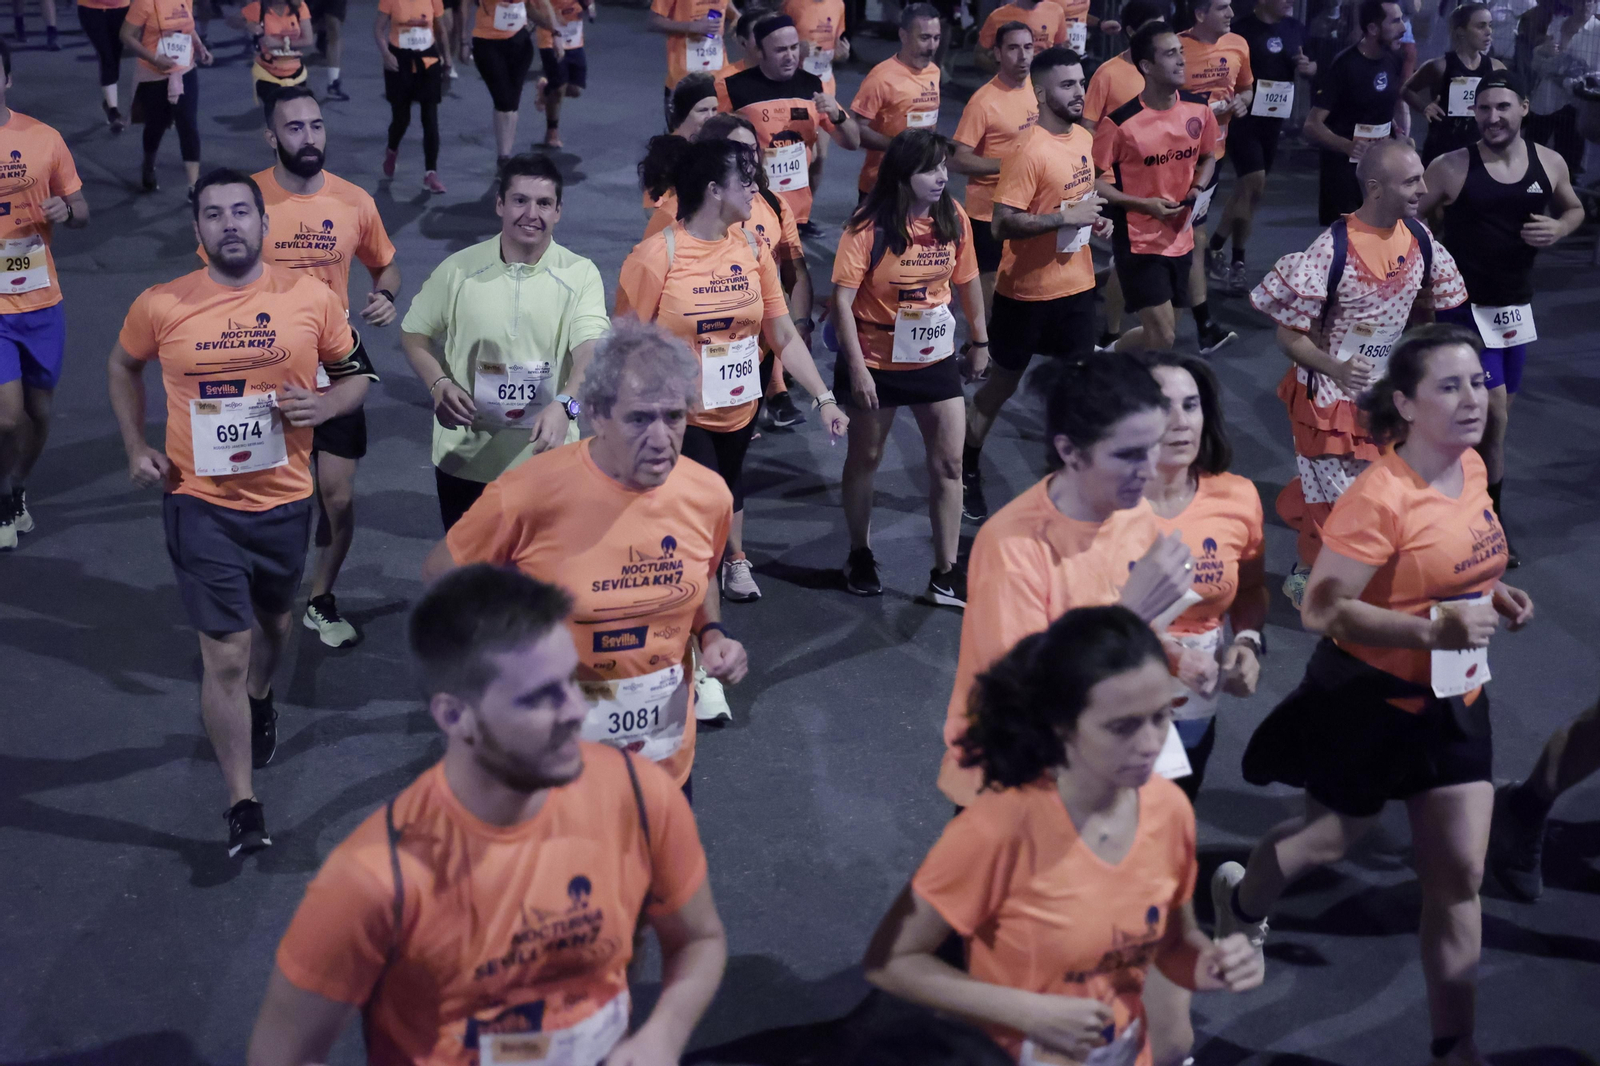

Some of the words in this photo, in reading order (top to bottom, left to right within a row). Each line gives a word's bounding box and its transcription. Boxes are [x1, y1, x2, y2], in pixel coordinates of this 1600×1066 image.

[1265, 93, 1288, 102] 10214
[770, 159, 800, 174] 11140
[294, 234, 337, 242] NOCTURNA
[917, 250, 950, 259] NOCTURNA
[6, 256, 30, 271] 299
[710, 276, 748, 286] NOCTURNA
[692, 285, 730, 294] SEVILLA
[1494, 308, 1522, 325] 4518
[220, 330, 276, 340] NOCTURNA
[911, 324, 946, 340] 17966
[195, 340, 246, 351] SEVILLA
[720, 359, 752, 380] 17968
[498, 384, 536, 400] 6213
[216, 420, 262, 442] 6974
[621, 559, 684, 576] NOCTURNA
[1454, 549, 1491, 575] SEVILLA
[592, 576, 650, 592] SEVILLA
[608, 705, 660, 734] 3081
